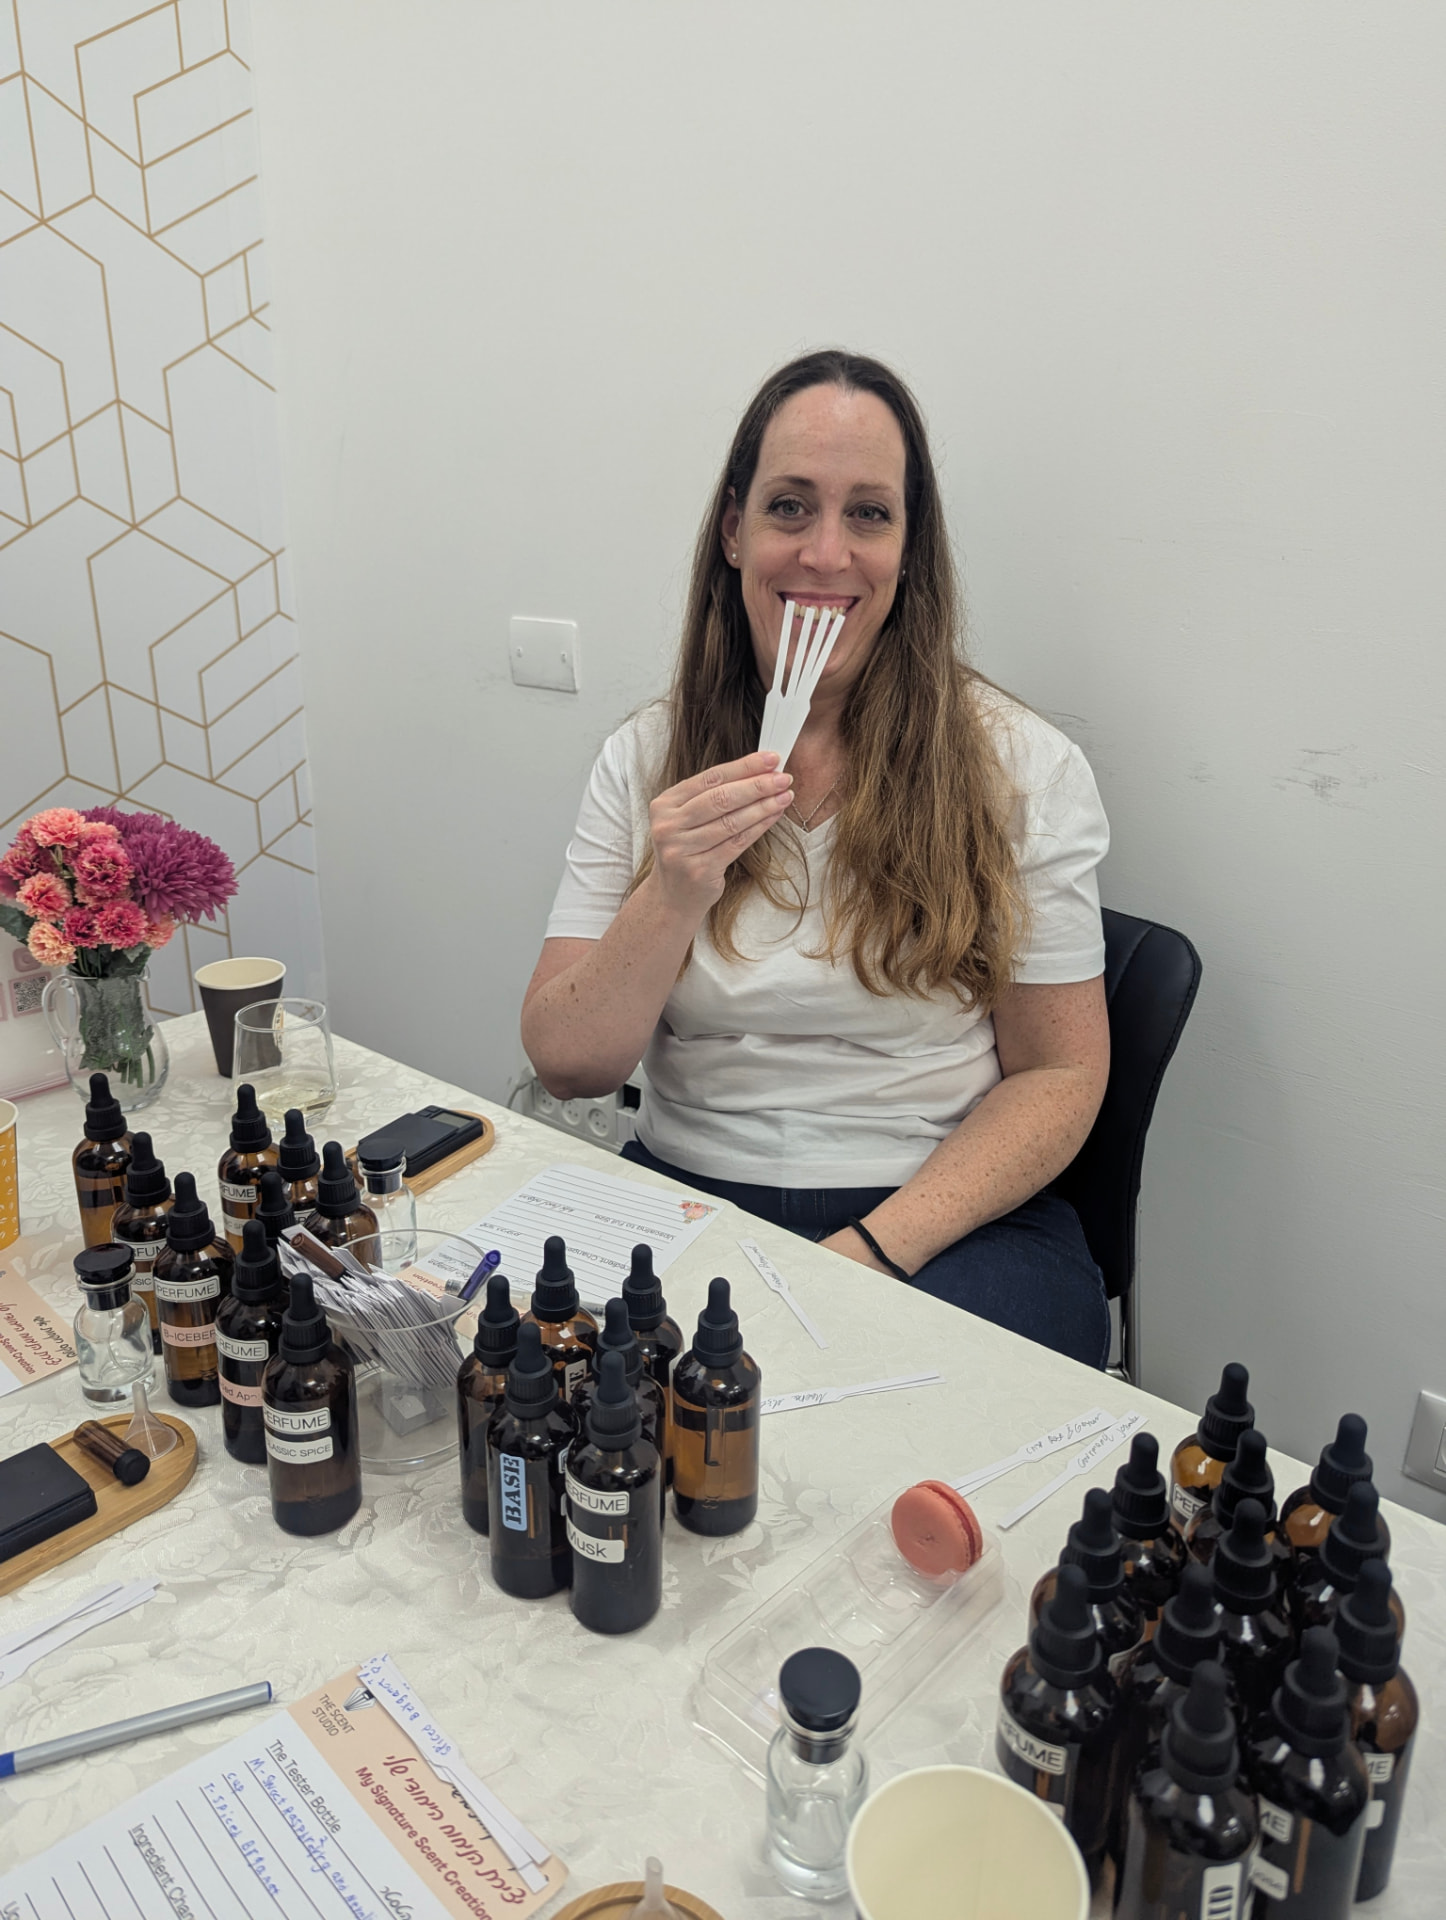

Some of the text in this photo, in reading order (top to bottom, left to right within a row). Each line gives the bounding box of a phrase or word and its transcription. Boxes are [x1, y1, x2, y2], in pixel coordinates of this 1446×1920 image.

[157, 1283, 216, 1299] PERFUME
[12, 1352, 36, 1374] Creation
[265, 1410, 328, 1430] ERFUME
[503, 1457, 521, 1525] BASE
[566, 1483, 626, 1512] ERFUME
[567, 1524, 608, 1559] Musk
[312, 1707, 339, 1736] STUDIO
[319, 1694, 356, 1733] THE SCENT
[382, 1755, 418, 1776] שלי
[269, 1739, 341, 1834] The Tester Bottle
[132, 1823, 175, 1888] Ingredient
[355, 1766, 375, 1787] My
[371, 1784, 418, 1839] Signature
[414, 1837, 448, 1872] Scent
[443, 1870, 492, 1920] Creation
